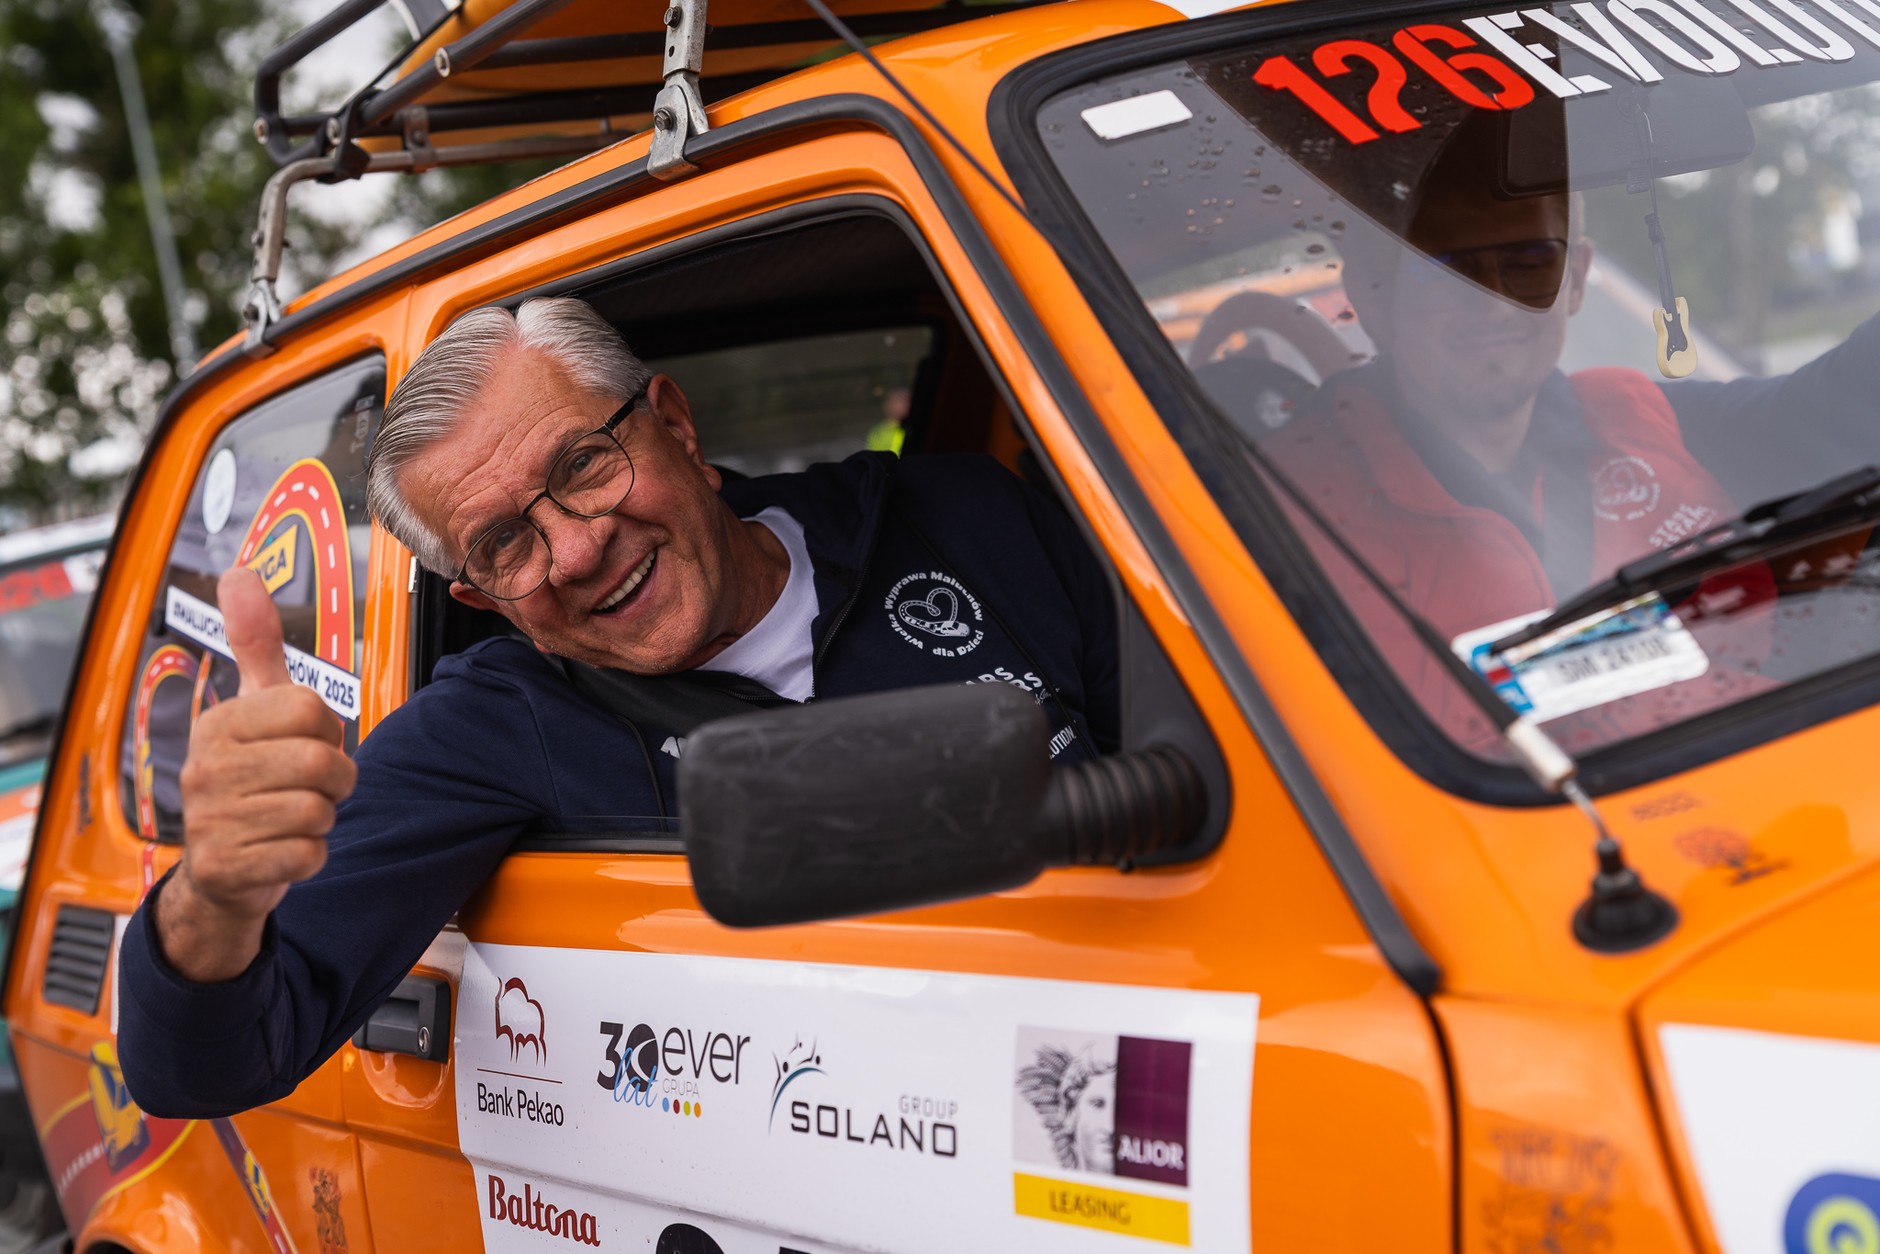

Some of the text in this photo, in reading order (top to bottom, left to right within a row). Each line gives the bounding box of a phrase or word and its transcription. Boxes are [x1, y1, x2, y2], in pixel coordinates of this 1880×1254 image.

[1461, 0, 1880, 98] EVOLU
[253, 548, 287, 582] YGA
[884, 571, 927, 610] Wyprawa
[888, 613, 924, 650] Wielka
[955, 629, 984, 656] Dzieci
[932, 647, 955, 657] dla
[284, 653, 320, 690] HÓW
[324, 676, 355, 709] 2025
[596, 1020, 751, 1093] 30 ever
[613, 1047, 658, 1108] lat
[662, 1078, 700, 1099] GRUPA
[476, 1082, 564, 1127] Bank Pekao
[898, 1094, 958, 1120] GROUP
[790, 1100, 958, 1158] SOLANO
[1118, 1134, 1186, 1171] ALIOR
[487, 1174, 601, 1248] Baltona
[1049, 1189, 1132, 1226] LEASING
